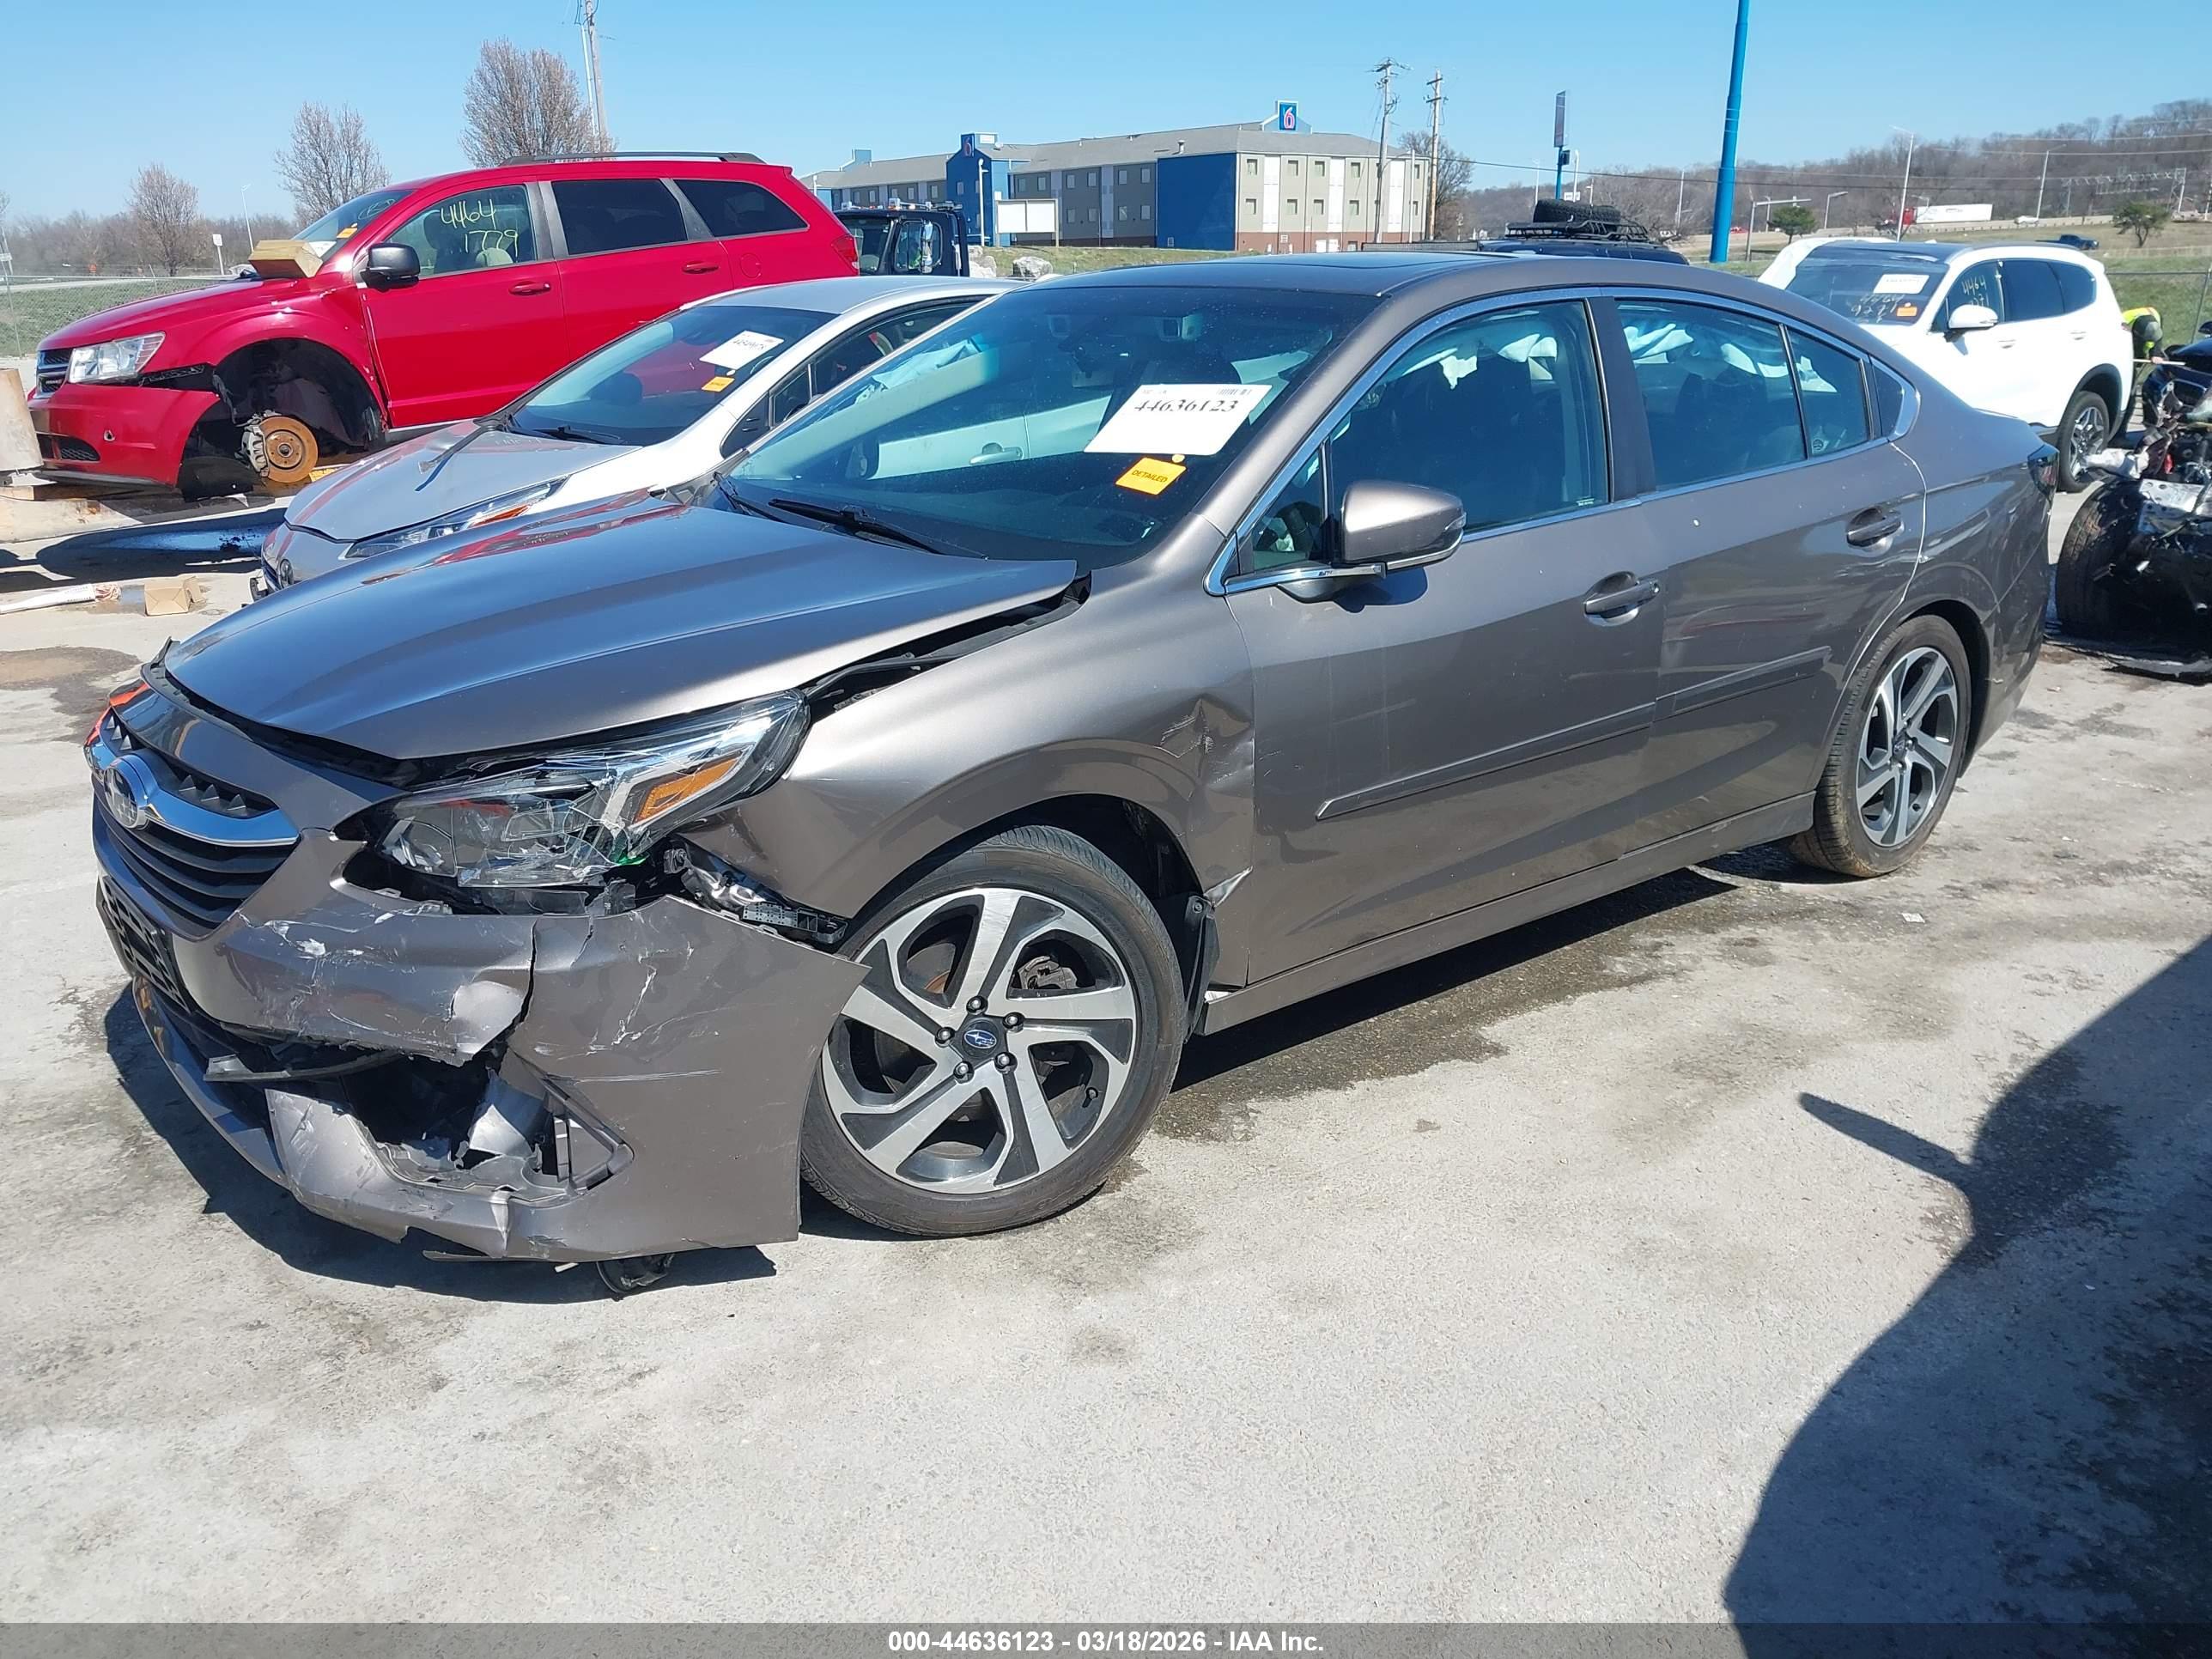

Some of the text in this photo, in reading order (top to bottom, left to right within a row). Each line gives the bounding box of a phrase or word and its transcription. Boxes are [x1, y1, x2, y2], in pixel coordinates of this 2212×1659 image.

[1284, 106, 1295, 130] 6
[441, 198, 496, 229] 4464
[465, 229, 518, 257] 1779
[1961, 274, 1987, 295] 4464
[1133, 399, 1239, 412] 44636123
[1131, 470, 1169, 483] DETAILED
